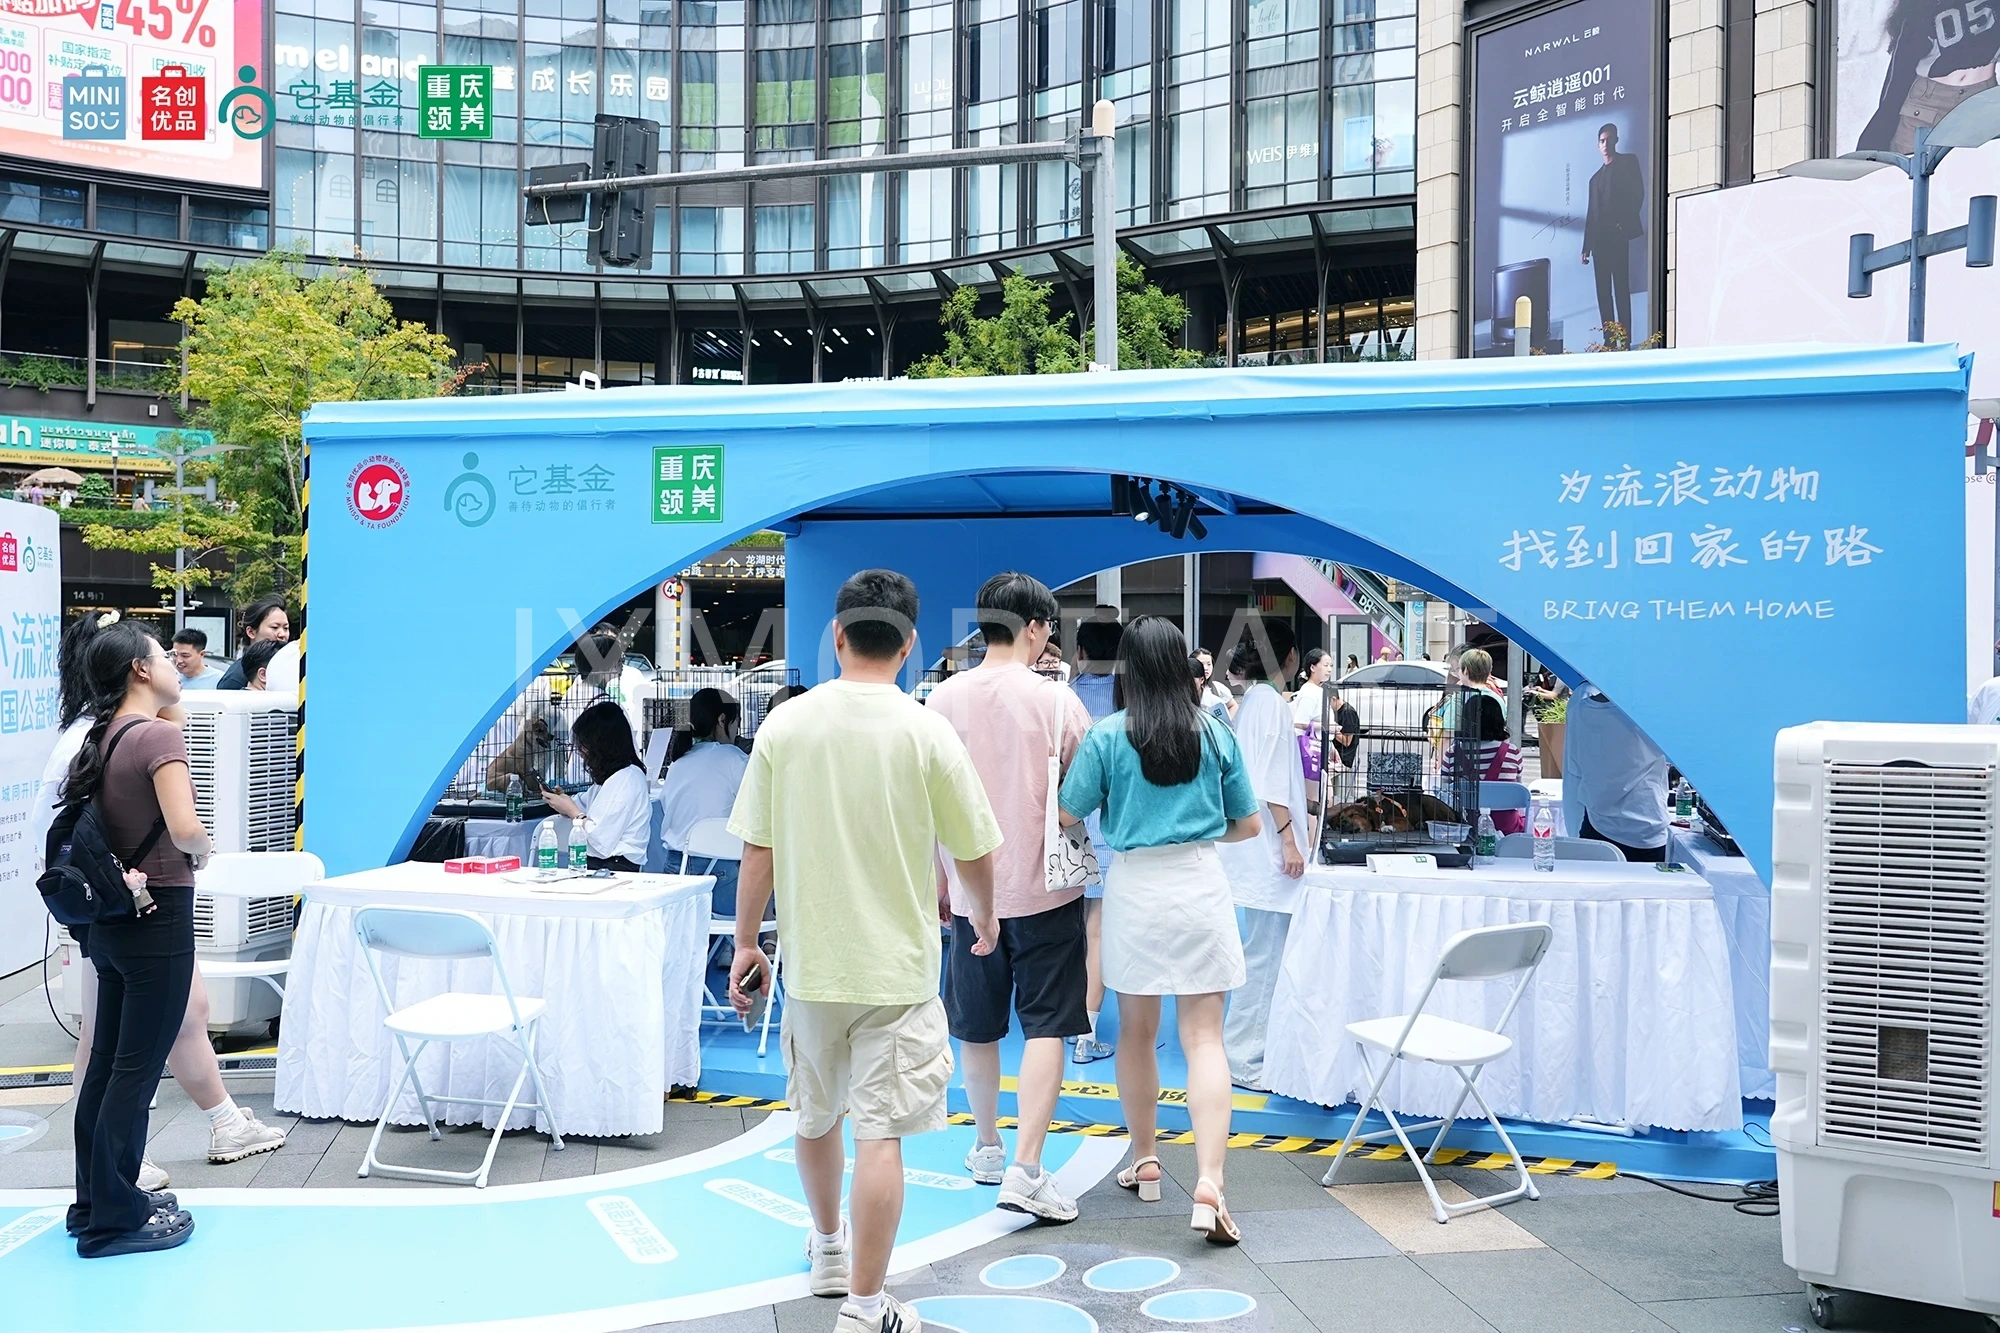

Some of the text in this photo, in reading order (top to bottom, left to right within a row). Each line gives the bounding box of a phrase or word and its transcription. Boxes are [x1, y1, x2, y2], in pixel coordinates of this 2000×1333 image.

[117, 0, 216, 48] 45%
[1935, 0, 1996, 48] 05
[62, 41, 112, 61] 国家指定
[1524, 34, 1581, 58] NARWAL
[48, 54, 122, 76] 补贴定位
[1513, 63, 1612, 109] 云鲸逍遥001
[1501, 85, 1625, 132] 开启全智能时代
[508, 463, 616, 496] 它基金
[660, 454, 715, 481] 重庆
[660, 484, 716, 515] 领养
[1557, 461, 1819, 509] 为流浪动物
[346, 496, 360, 521] MINISO
[377, 494, 411, 530] FOUNDATION
[508, 499, 616, 513] 善待动物的倡行者
[1499, 523, 1884, 572] 找到回家的路
[1543, 599, 1835, 620] BRING THEM HOME
